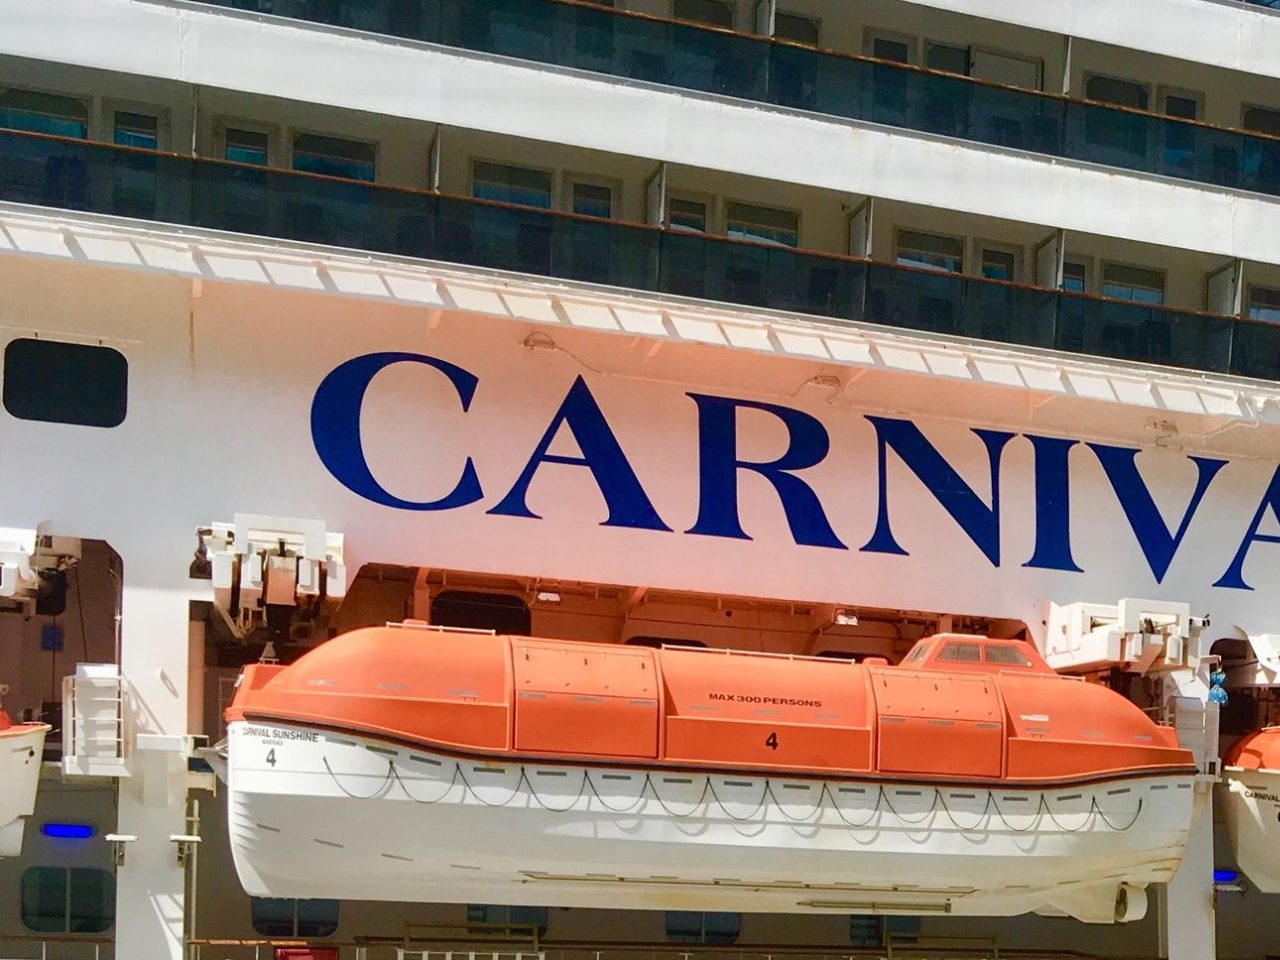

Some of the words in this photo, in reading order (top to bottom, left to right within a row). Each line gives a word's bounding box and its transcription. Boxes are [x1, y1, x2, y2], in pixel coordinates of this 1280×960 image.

[708, 693, 735, 702] MAX
[736, 695, 762, 703] 300
[763, 697, 822, 707] PERSONS
[242, 727, 271, 738] CARNIVAL
[272, 729, 319, 742] SUNSHINE
[765, 731, 779, 751] 4
[265, 748, 277, 768] 4
[1244, 790, 1280, 802] CARNIVAL
